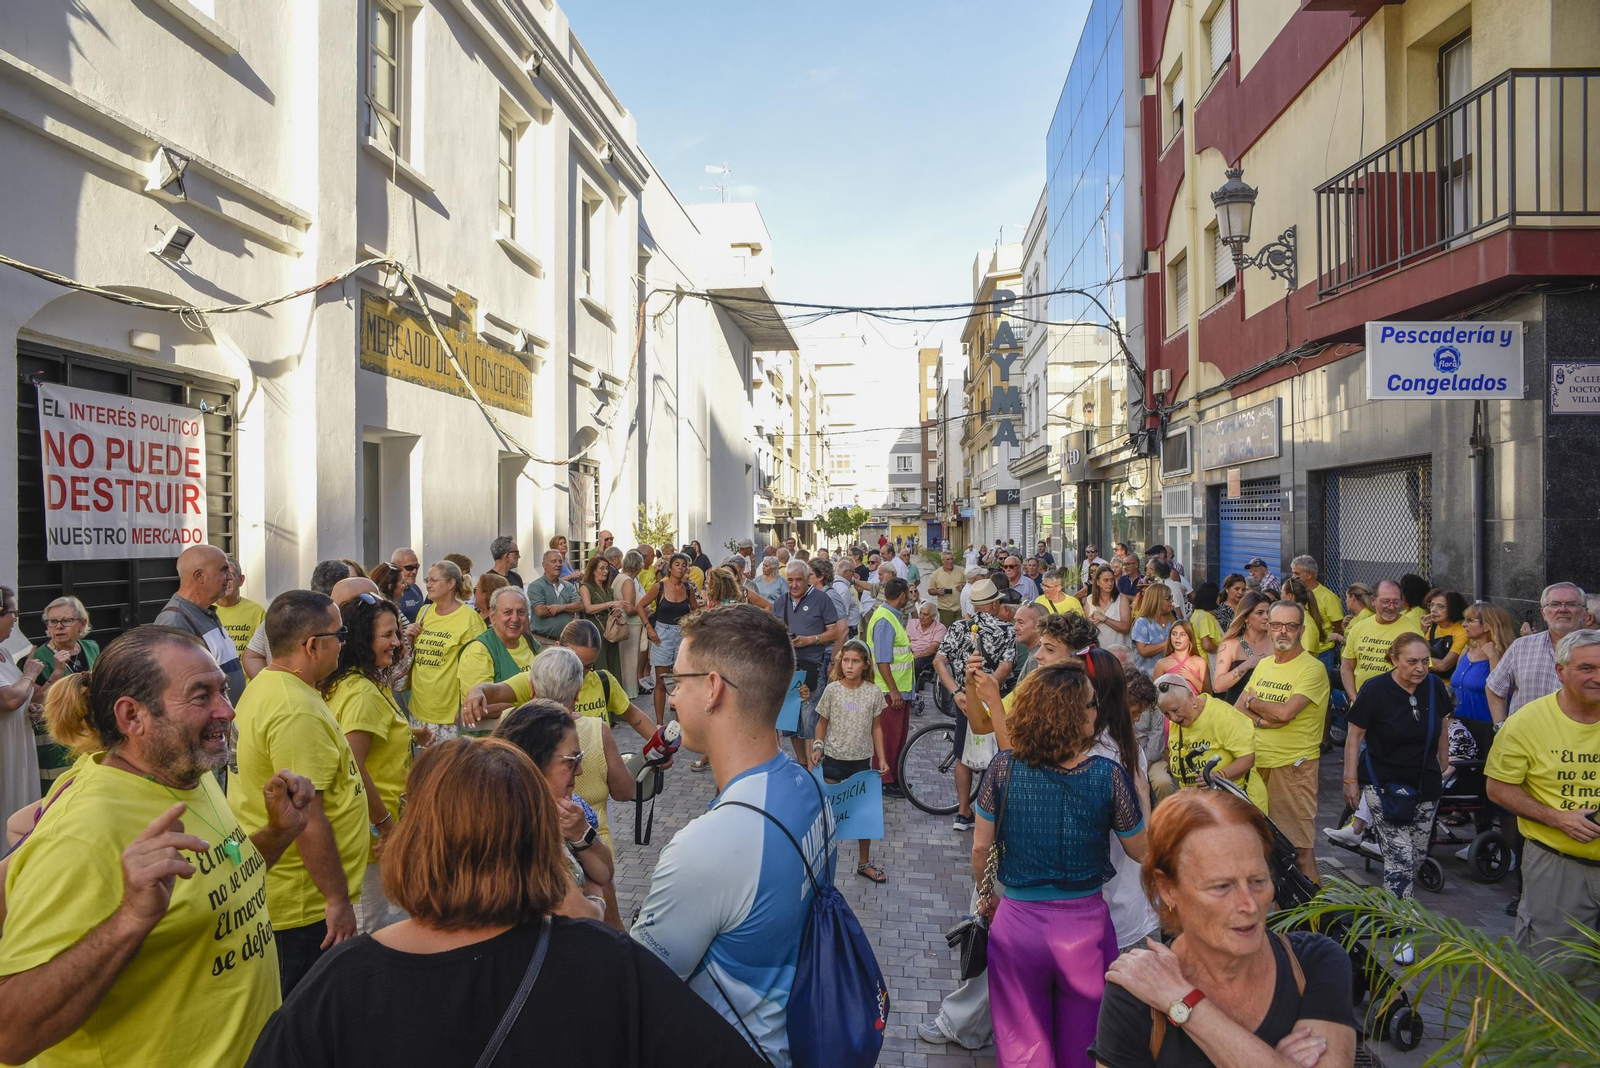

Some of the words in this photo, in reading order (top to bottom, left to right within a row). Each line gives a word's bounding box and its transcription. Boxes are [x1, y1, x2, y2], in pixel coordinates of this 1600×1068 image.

[366, 311, 431, 369] MERCADO
[435, 337, 451, 376] DE
[455, 347, 470, 381] LA
[1380, 325, 1494, 344] Pescadería
[1499, 329, 1513, 348] y
[990, 289, 1021, 448] PAYMA
[1438, 360, 1457, 369] flora
[1387, 374, 1507, 395] Congelados
[42, 398, 65, 419] EL
[69, 402, 137, 428] INTERÉS
[141, 413, 199, 436] POLÍTICO
[43, 429, 95, 469] NO
[106, 437, 201, 478] PUEDE
[46, 474, 202, 514] DESTRUIR
[48, 526, 127, 545] NUESTRO
[131, 528, 203, 544] MERCADO
[1557, 770, 1577, 781] no
[1581, 770, 1597, 781] se
[1561, 783, 1575, 797] El
[1560, 799, 1576, 811] se
[207, 883, 228, 912] no
[229, 871, 242, 894] se
[214, 909, 233, 941] El
[211, 950, 236, 976] se
